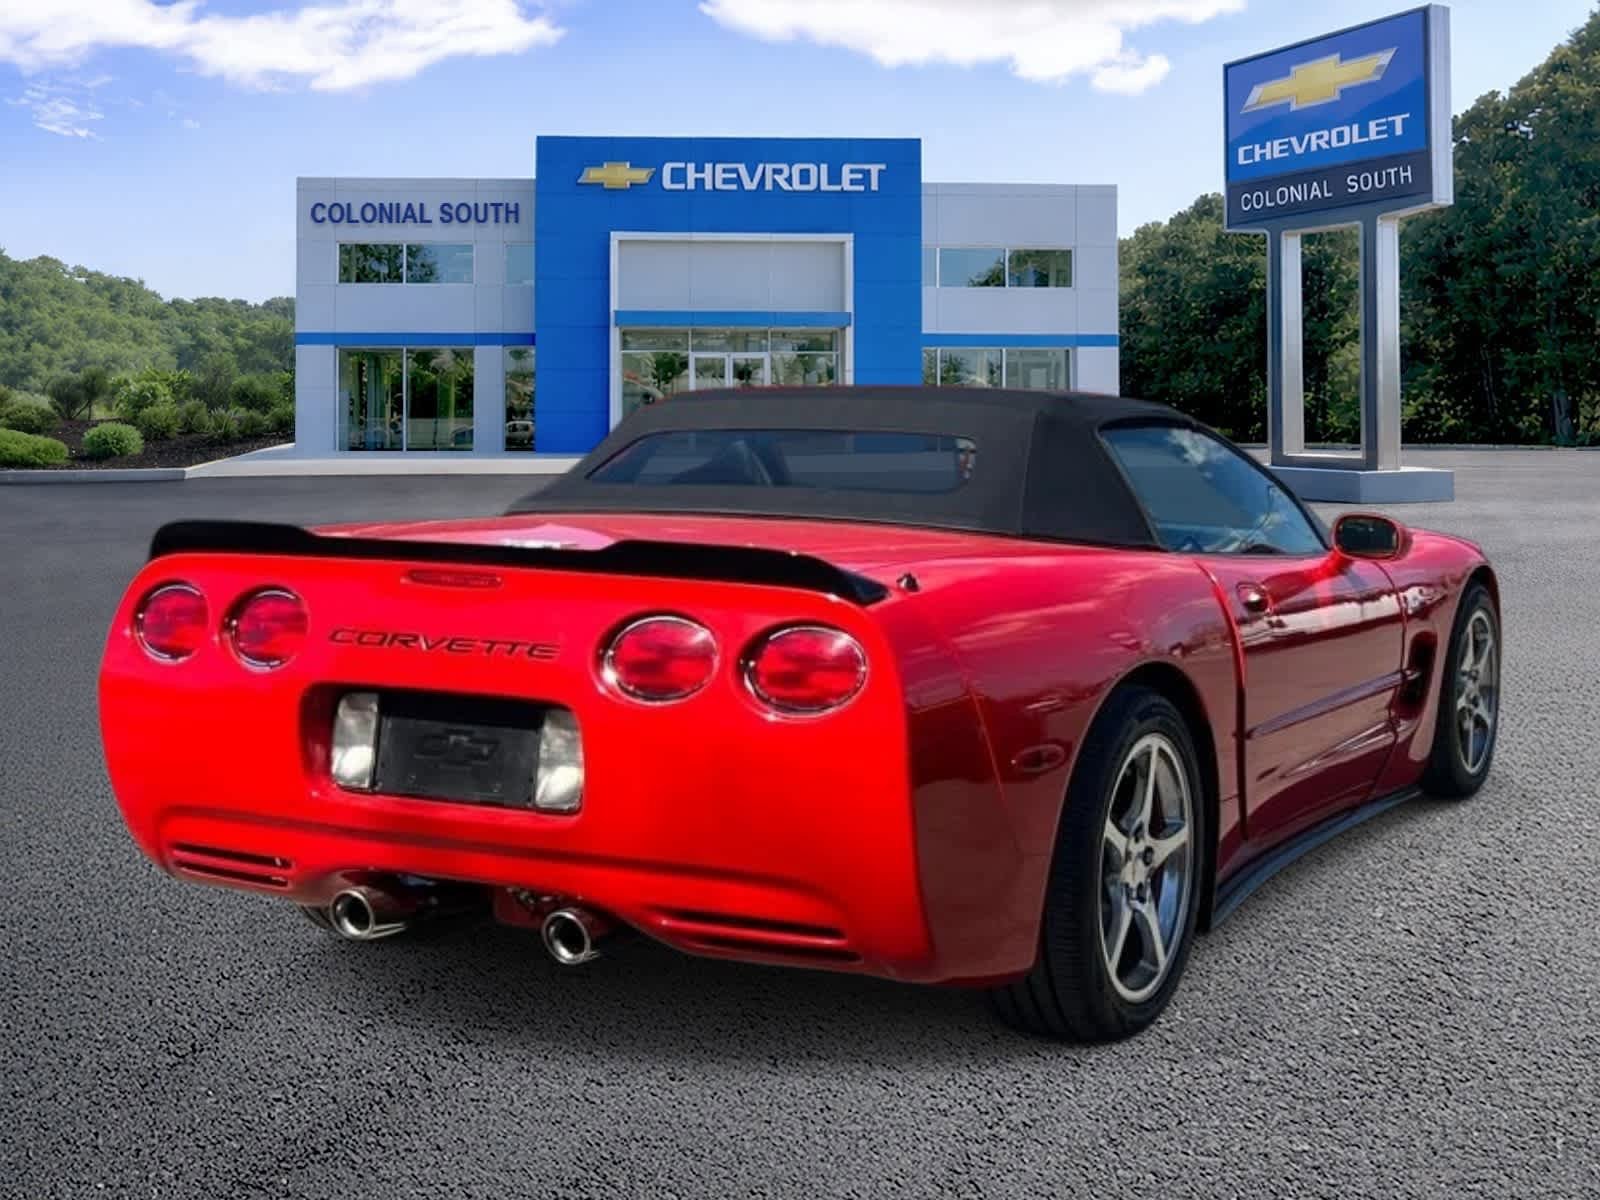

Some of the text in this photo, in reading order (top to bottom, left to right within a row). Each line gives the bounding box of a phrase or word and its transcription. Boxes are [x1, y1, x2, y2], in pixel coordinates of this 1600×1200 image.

[1238, 113, 1410, 165] CHEVROLET
[661, 161, 887, 192] CHEVROLET
[1240, 165, 1412, 211] COLONIAL SOUTH
[310, 202, 520, 225] COLONIAL SOUTH
[329, 628, 560, 660] CORVETTE
